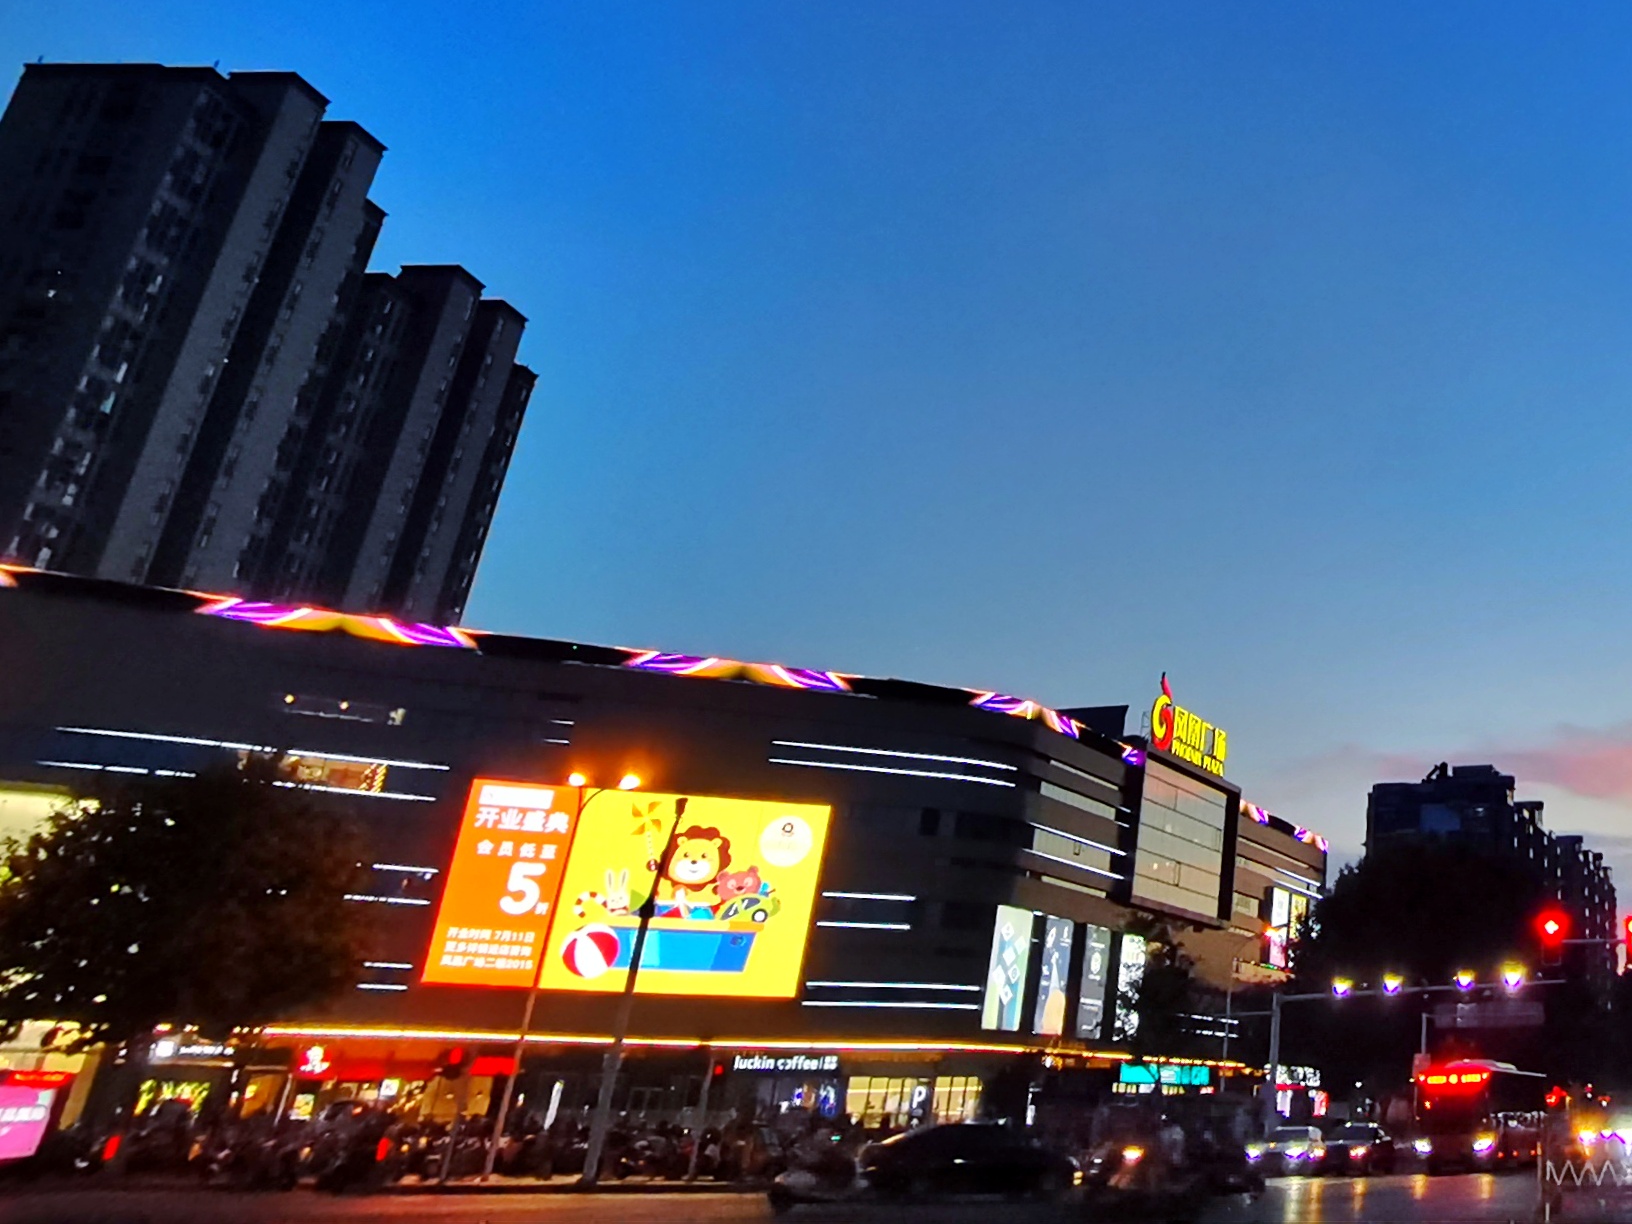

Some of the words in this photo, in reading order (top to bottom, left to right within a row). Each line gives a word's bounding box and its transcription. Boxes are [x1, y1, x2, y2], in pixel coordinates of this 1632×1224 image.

[1173, 705, 1227, 762] 凤凰广场
[474, 807, 570, 833] 开业盛典
[476, 839, 557, 859] 会员低至
[734, 1055, 775, 1071] luckin
[776, 1055, 820, 1071] coffee
